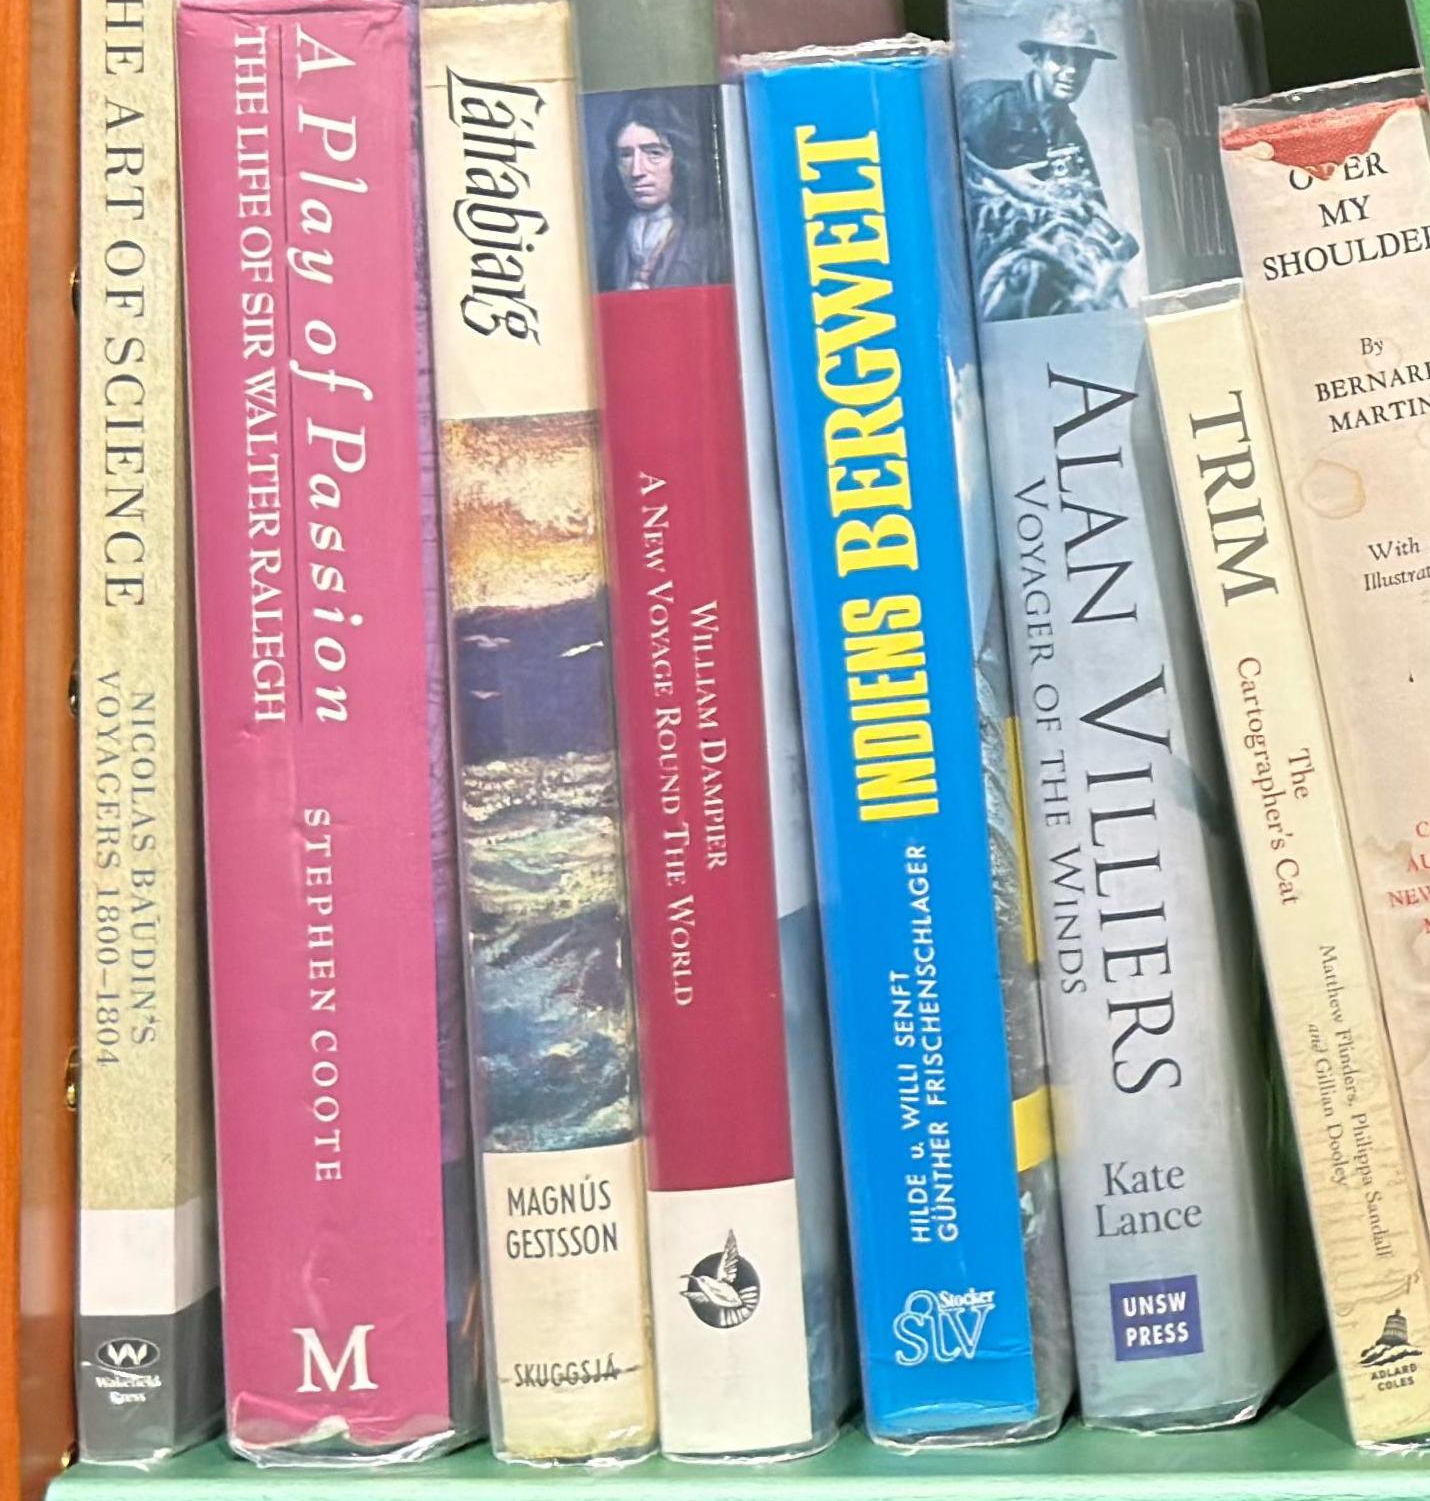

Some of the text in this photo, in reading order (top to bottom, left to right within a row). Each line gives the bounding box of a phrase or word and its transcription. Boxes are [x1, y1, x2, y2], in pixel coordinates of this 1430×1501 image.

[104, 99, 144, 221] ART
[1320, 196, 1371, 228] MY
[104, 240, 146, 318] OF
[235, 26, 287, 724] THE LIFE OF SIR WALTER RALEGH
[288, 25, 374, 724] A Play of Passion
[1360, 336, 1384, 356] By
[103, 337, 146, 609] SCIENCE
[796, 125, 939, 822] INDIENS BERGWELT
[1189, 390, 1279, 607] TRIM
[1369, 538, 1420, 561] With
[95, 669, 124, 873] VOYAGERS
[129, 692, 155, 858] NICOLAS
[1047, 363, 1182, 1095] ALAN VILLIERS
[1237, 657, 1299, 906] Cartographer's Cat
[1288, 748, 1313, 800] The
[305, 809, 342, 1183] STEPHEN COOTE
[907, 846, 958, 1241] GÜNTHER FRISCHENSCHLAGER
[889, 970, 931, 1242] HILDE WILLI SENFT
[1316, 1058, 1349, 1189] Gillian Dooley
[1319, 945, 1376, 1186] Matthew Philippa
[506, 1221, 618, 1260] GESTSSON
[508, 1174, 612, 1217] MAGNÚS
[1097, 1199, 1202, 1237] Lance
[1102, 1161, 1185, 1197] Kate
[293, 1325, 378, 1392] M
[1123, 1291, 1187, 1317] UNSW
[1126, 1320, 1189, 1347] PRESS
[514, 1353, 619, 1388] SKUGGSJÁ
